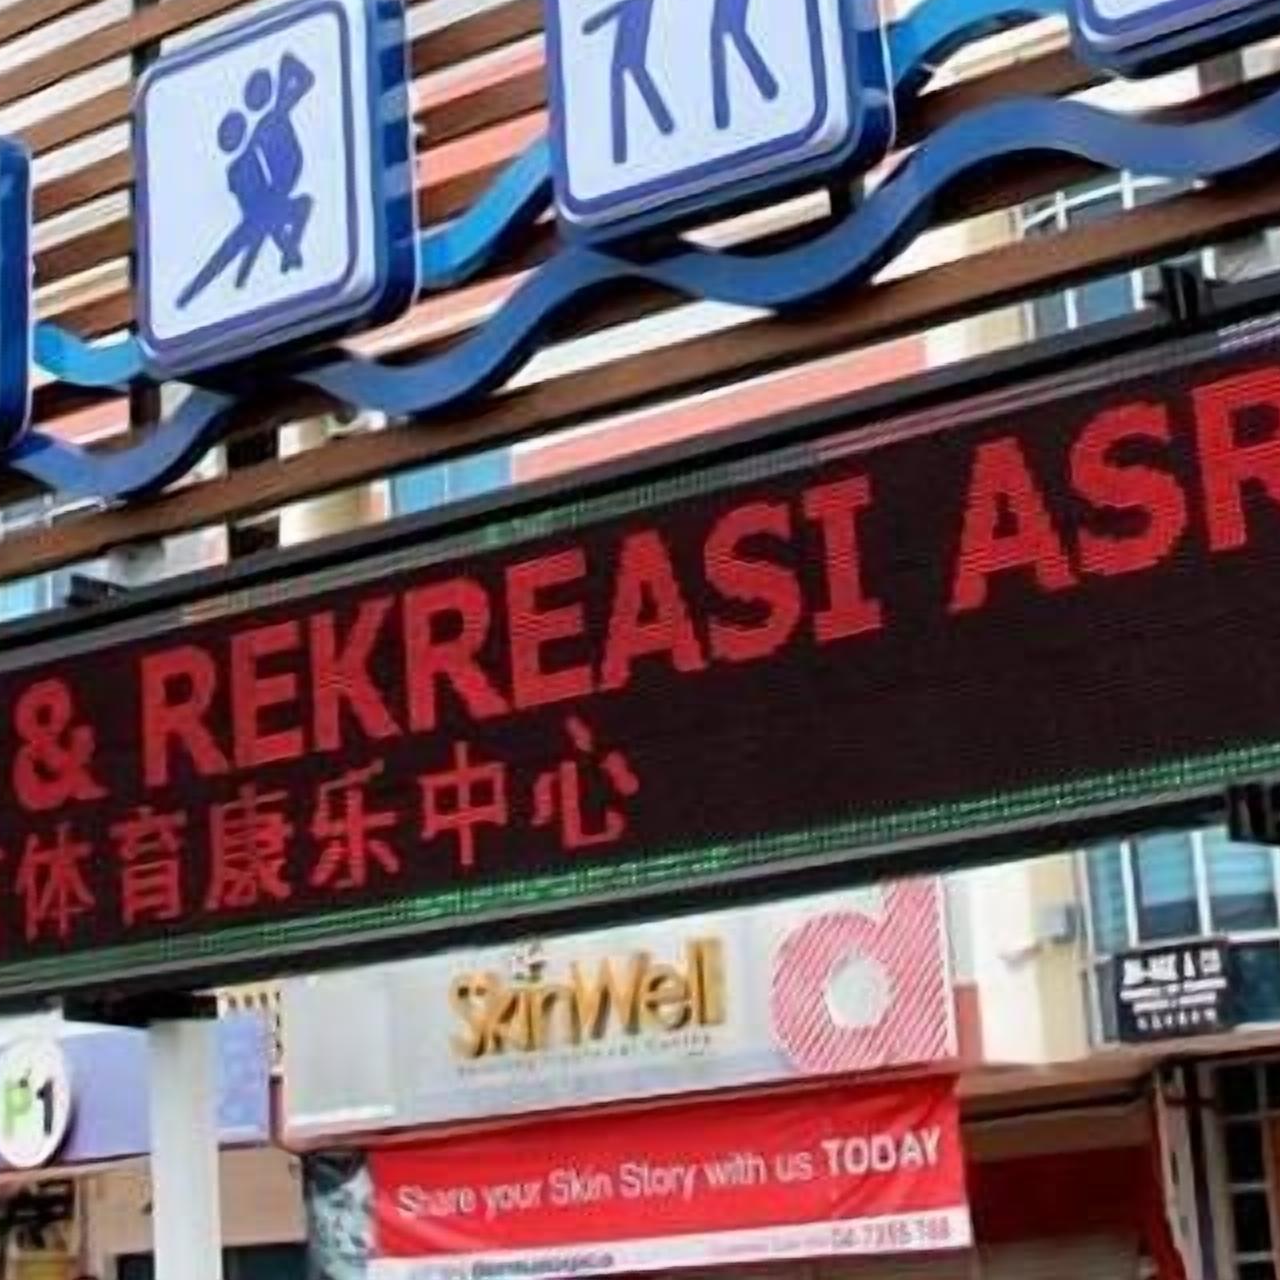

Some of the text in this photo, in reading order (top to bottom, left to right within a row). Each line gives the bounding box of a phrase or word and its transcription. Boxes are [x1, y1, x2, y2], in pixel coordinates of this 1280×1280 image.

[11, 677, 108, 812] &
[140, 474, 885, 788] REKREASI
[396, 1126, 942, 1222] Share your Skin Story with us TODAY
